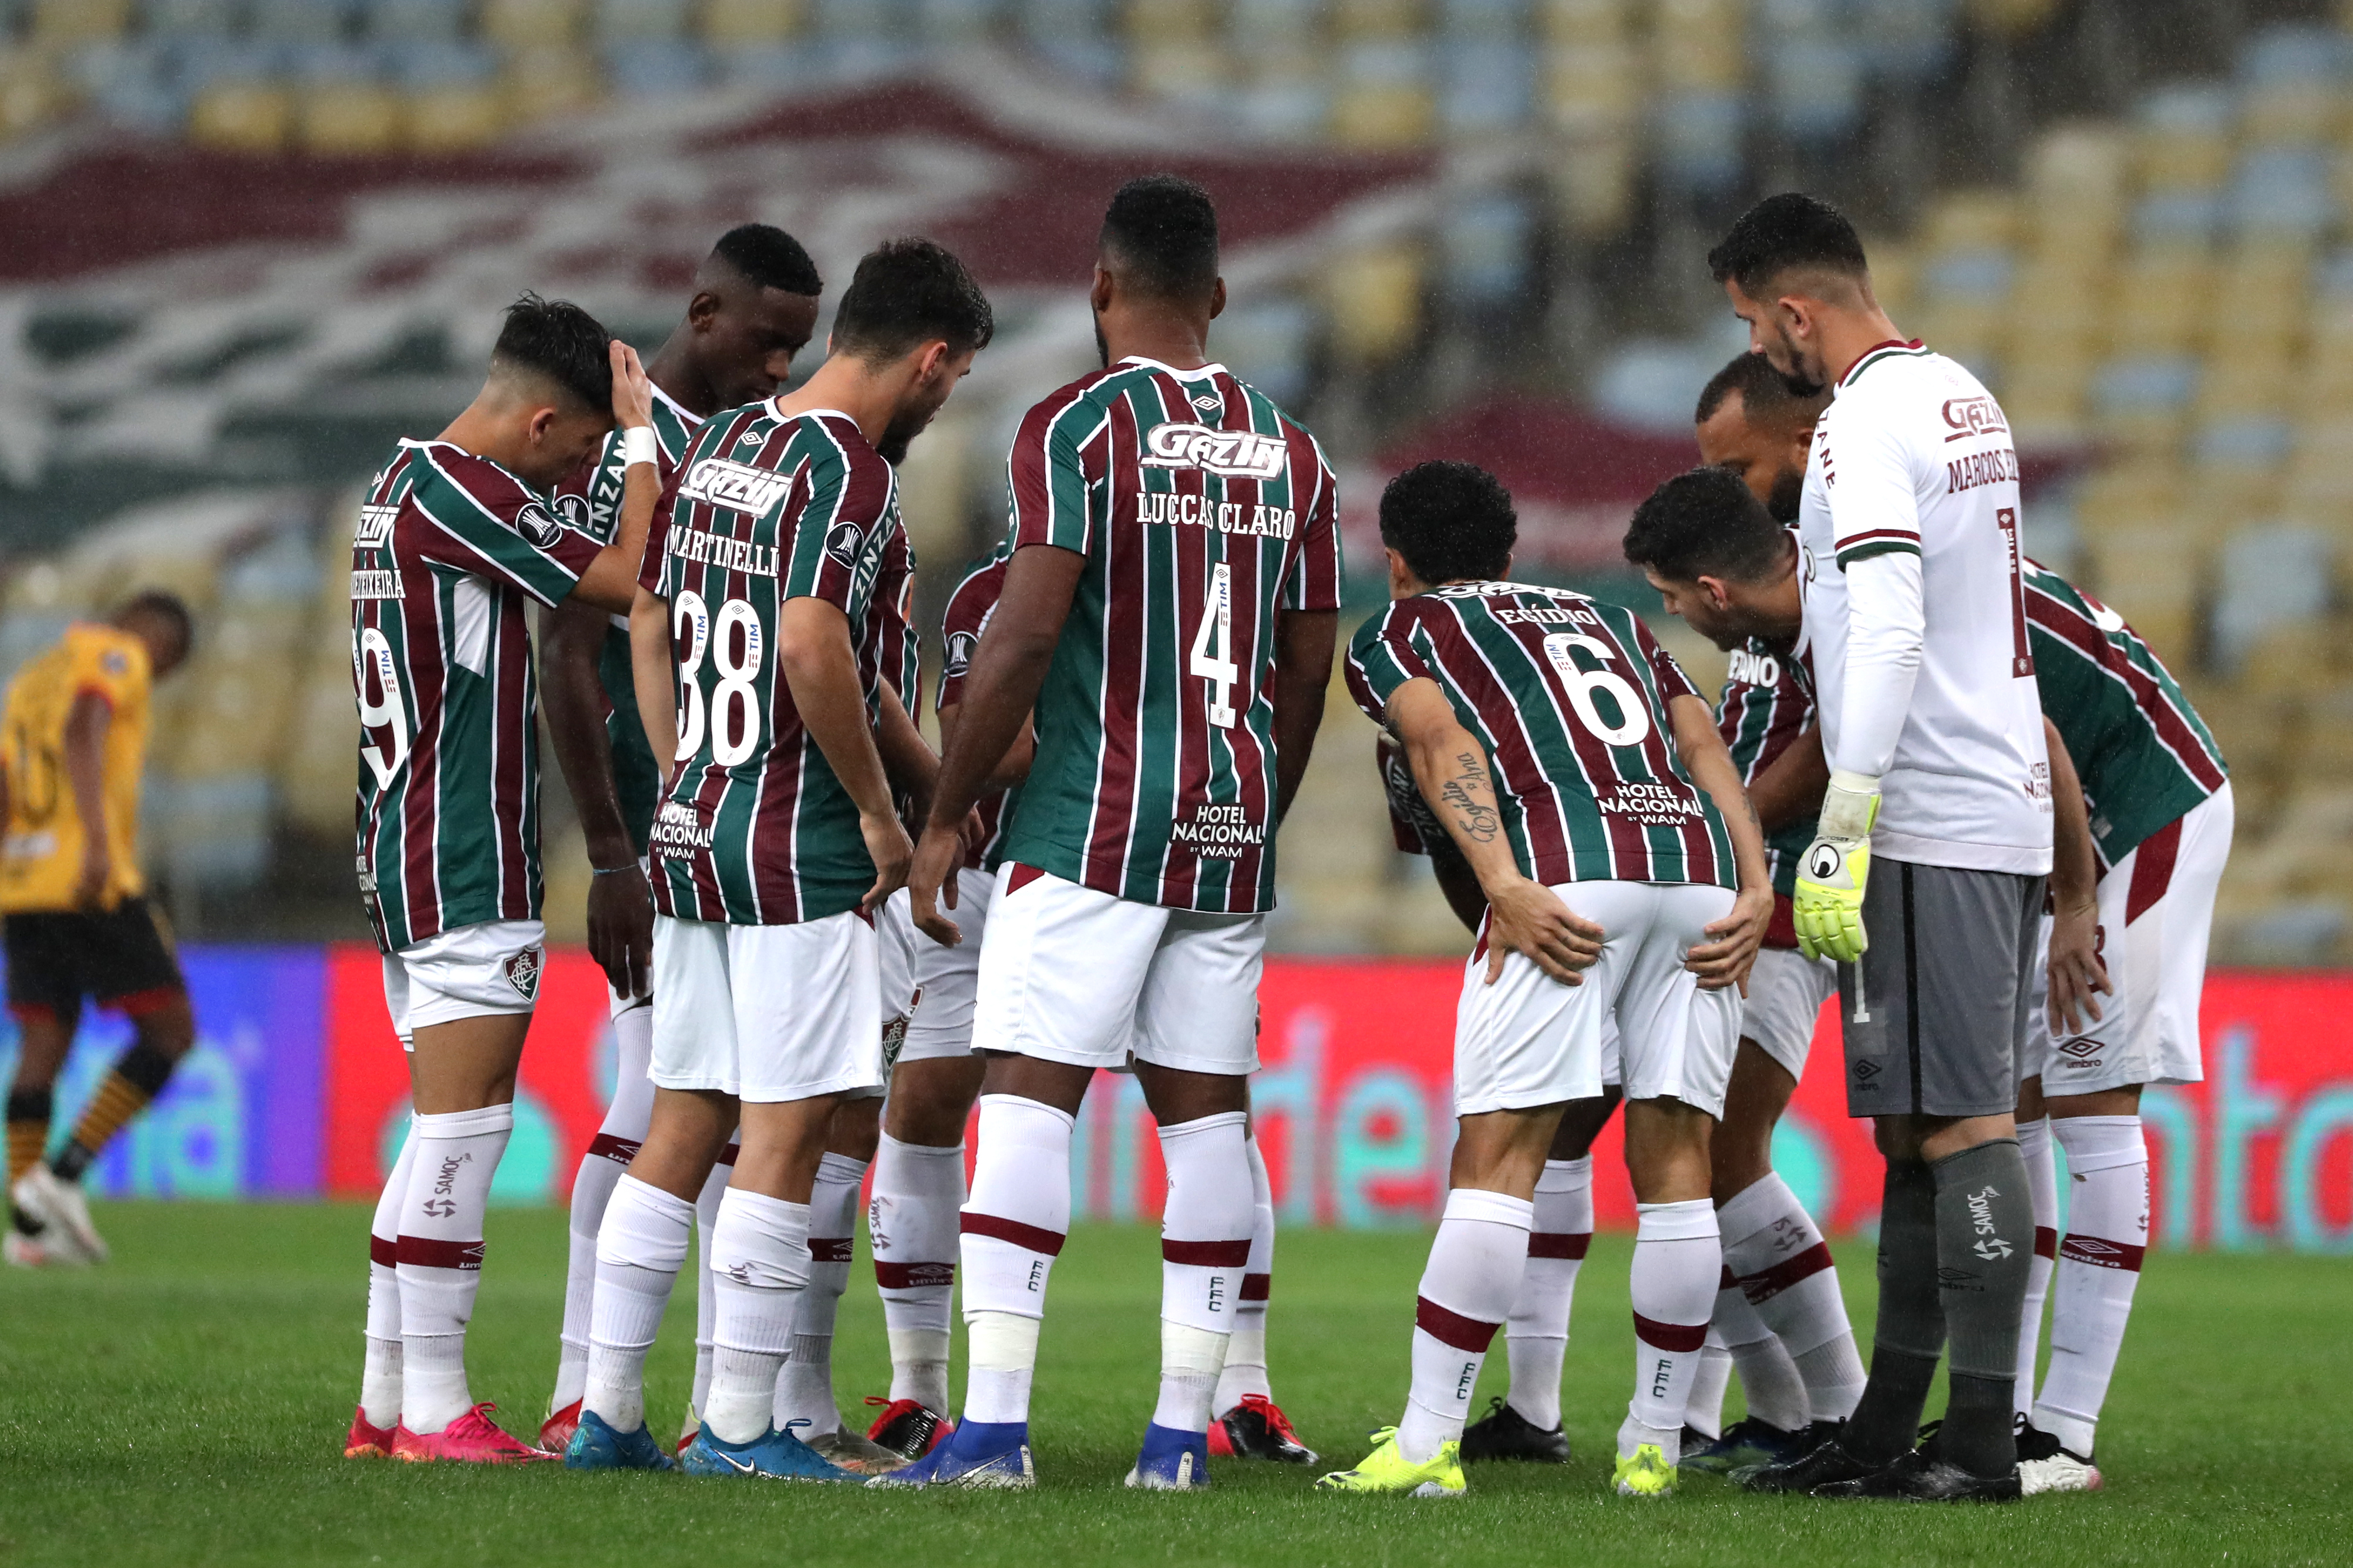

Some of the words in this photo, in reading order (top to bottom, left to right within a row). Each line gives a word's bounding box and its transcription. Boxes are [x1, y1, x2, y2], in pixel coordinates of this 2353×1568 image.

[1141, 424, 1287, 478] GAZIN
[1947, 450, 2005, 494] MARCOS
[678, 458, 793, 515] GAZIN
[1136, 493, 1213, 530] LUCCAS
[1218, 501, 1295, 541] CLARO
[669, 524, 779, 577] MARTINELLI
[1219, 582, 1228, 608] TIM
[696, 615, 706, 642] TIM
[749, 623, 759, 650] TIM
[1190, 562, 1238, 729] 4
[1546, 644, 1564, 660] TIM
[382, 650, 392, 676] TIM
[674, 590, 763, 767] 38
[1543, 633, 1649, 746] 6
[1615, 784, 1678, 799] HOTEL
[660, 805, 698, 827] HOTEL
[1196, 806, 1246, 824] HOTEL
[1598, 798, 1703, 817] NACIONAL
[1640, 815, 1687, 825] WAM
[649, 822, 711, 848] NACIONAL
[1172, 822, 1263, 844] NACIONAL
[664, 846, 695, 860] WAM
[1201, 845, 1243, 858] WAM
[435, 1156, 463, 1195] SAMOC
[1967, 1191, 1995, 1235] SAMOC
